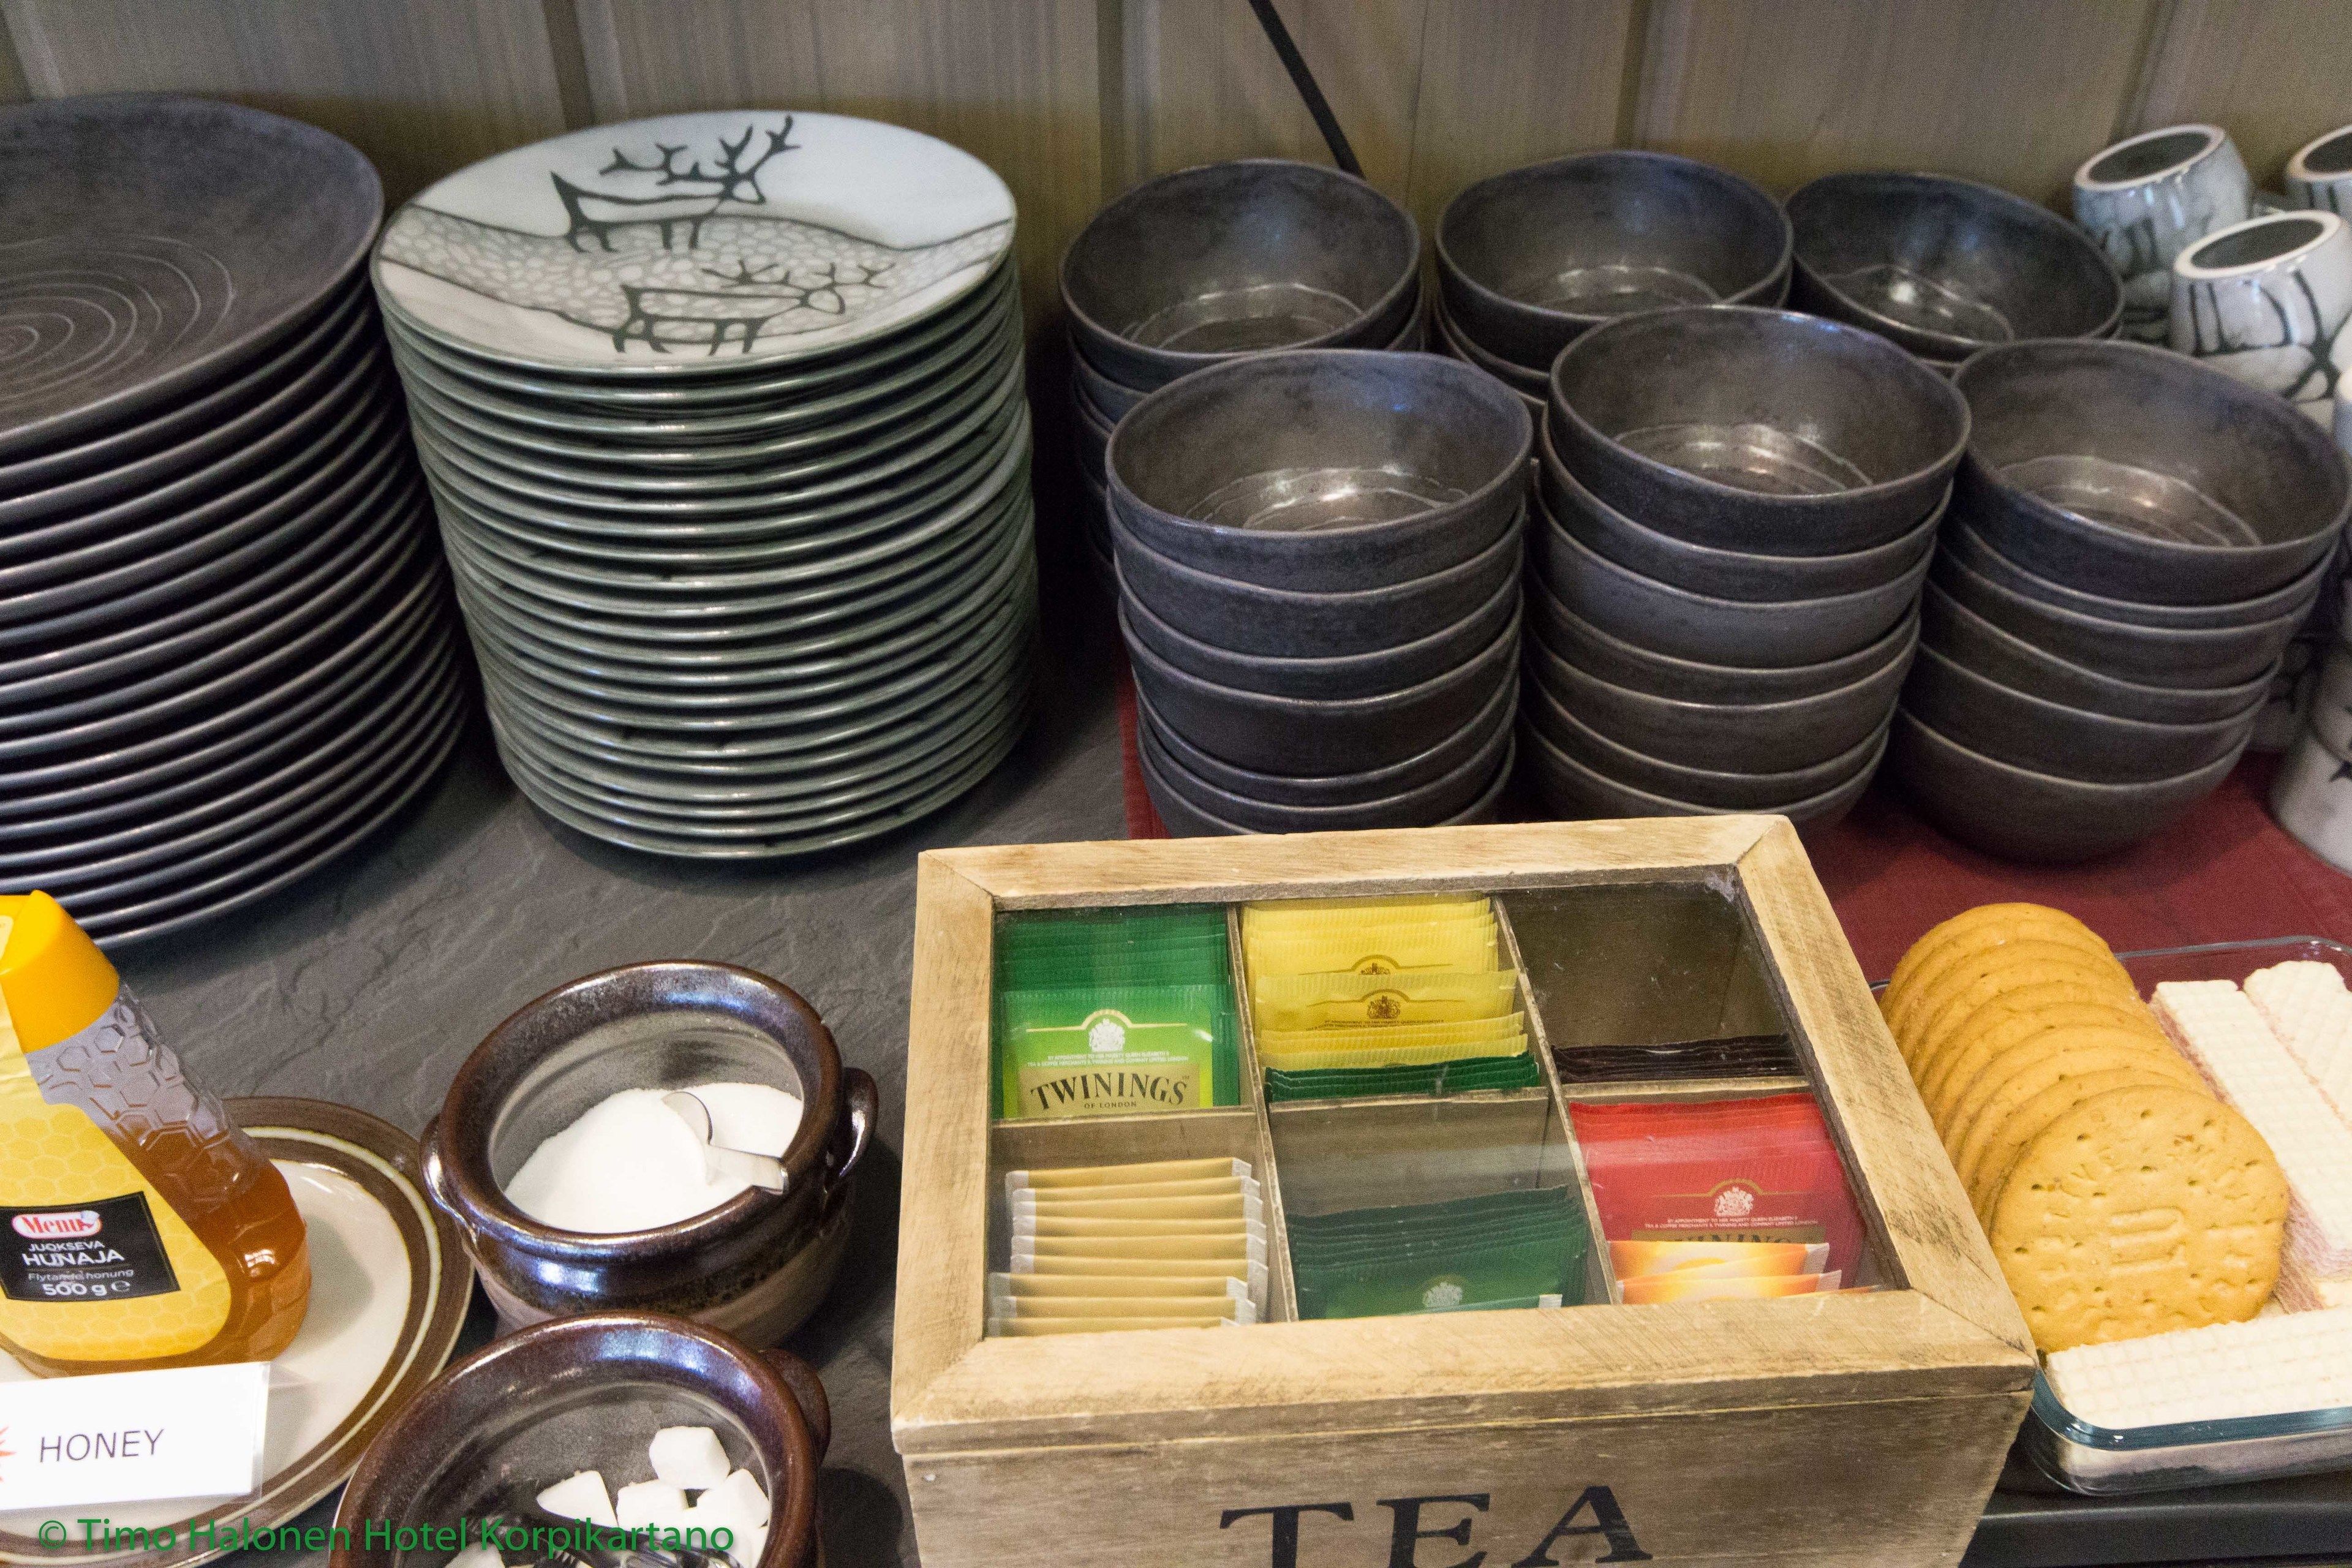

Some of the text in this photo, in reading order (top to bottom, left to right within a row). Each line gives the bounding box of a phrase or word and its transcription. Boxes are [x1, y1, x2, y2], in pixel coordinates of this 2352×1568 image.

[1030, 1072, 1187, 1110] TWININGS
[28, 1240, 105, 1253] JUOKSEVA
[21, 1249, 125, 1267] HUNAJA
[86, 1269, 134, 1280] honung
[42, 1283, 107, 1297] 500 g
[39, 1428, 165, 1463] HONEY
[1219, 1485, 1653, 1568] TEA
